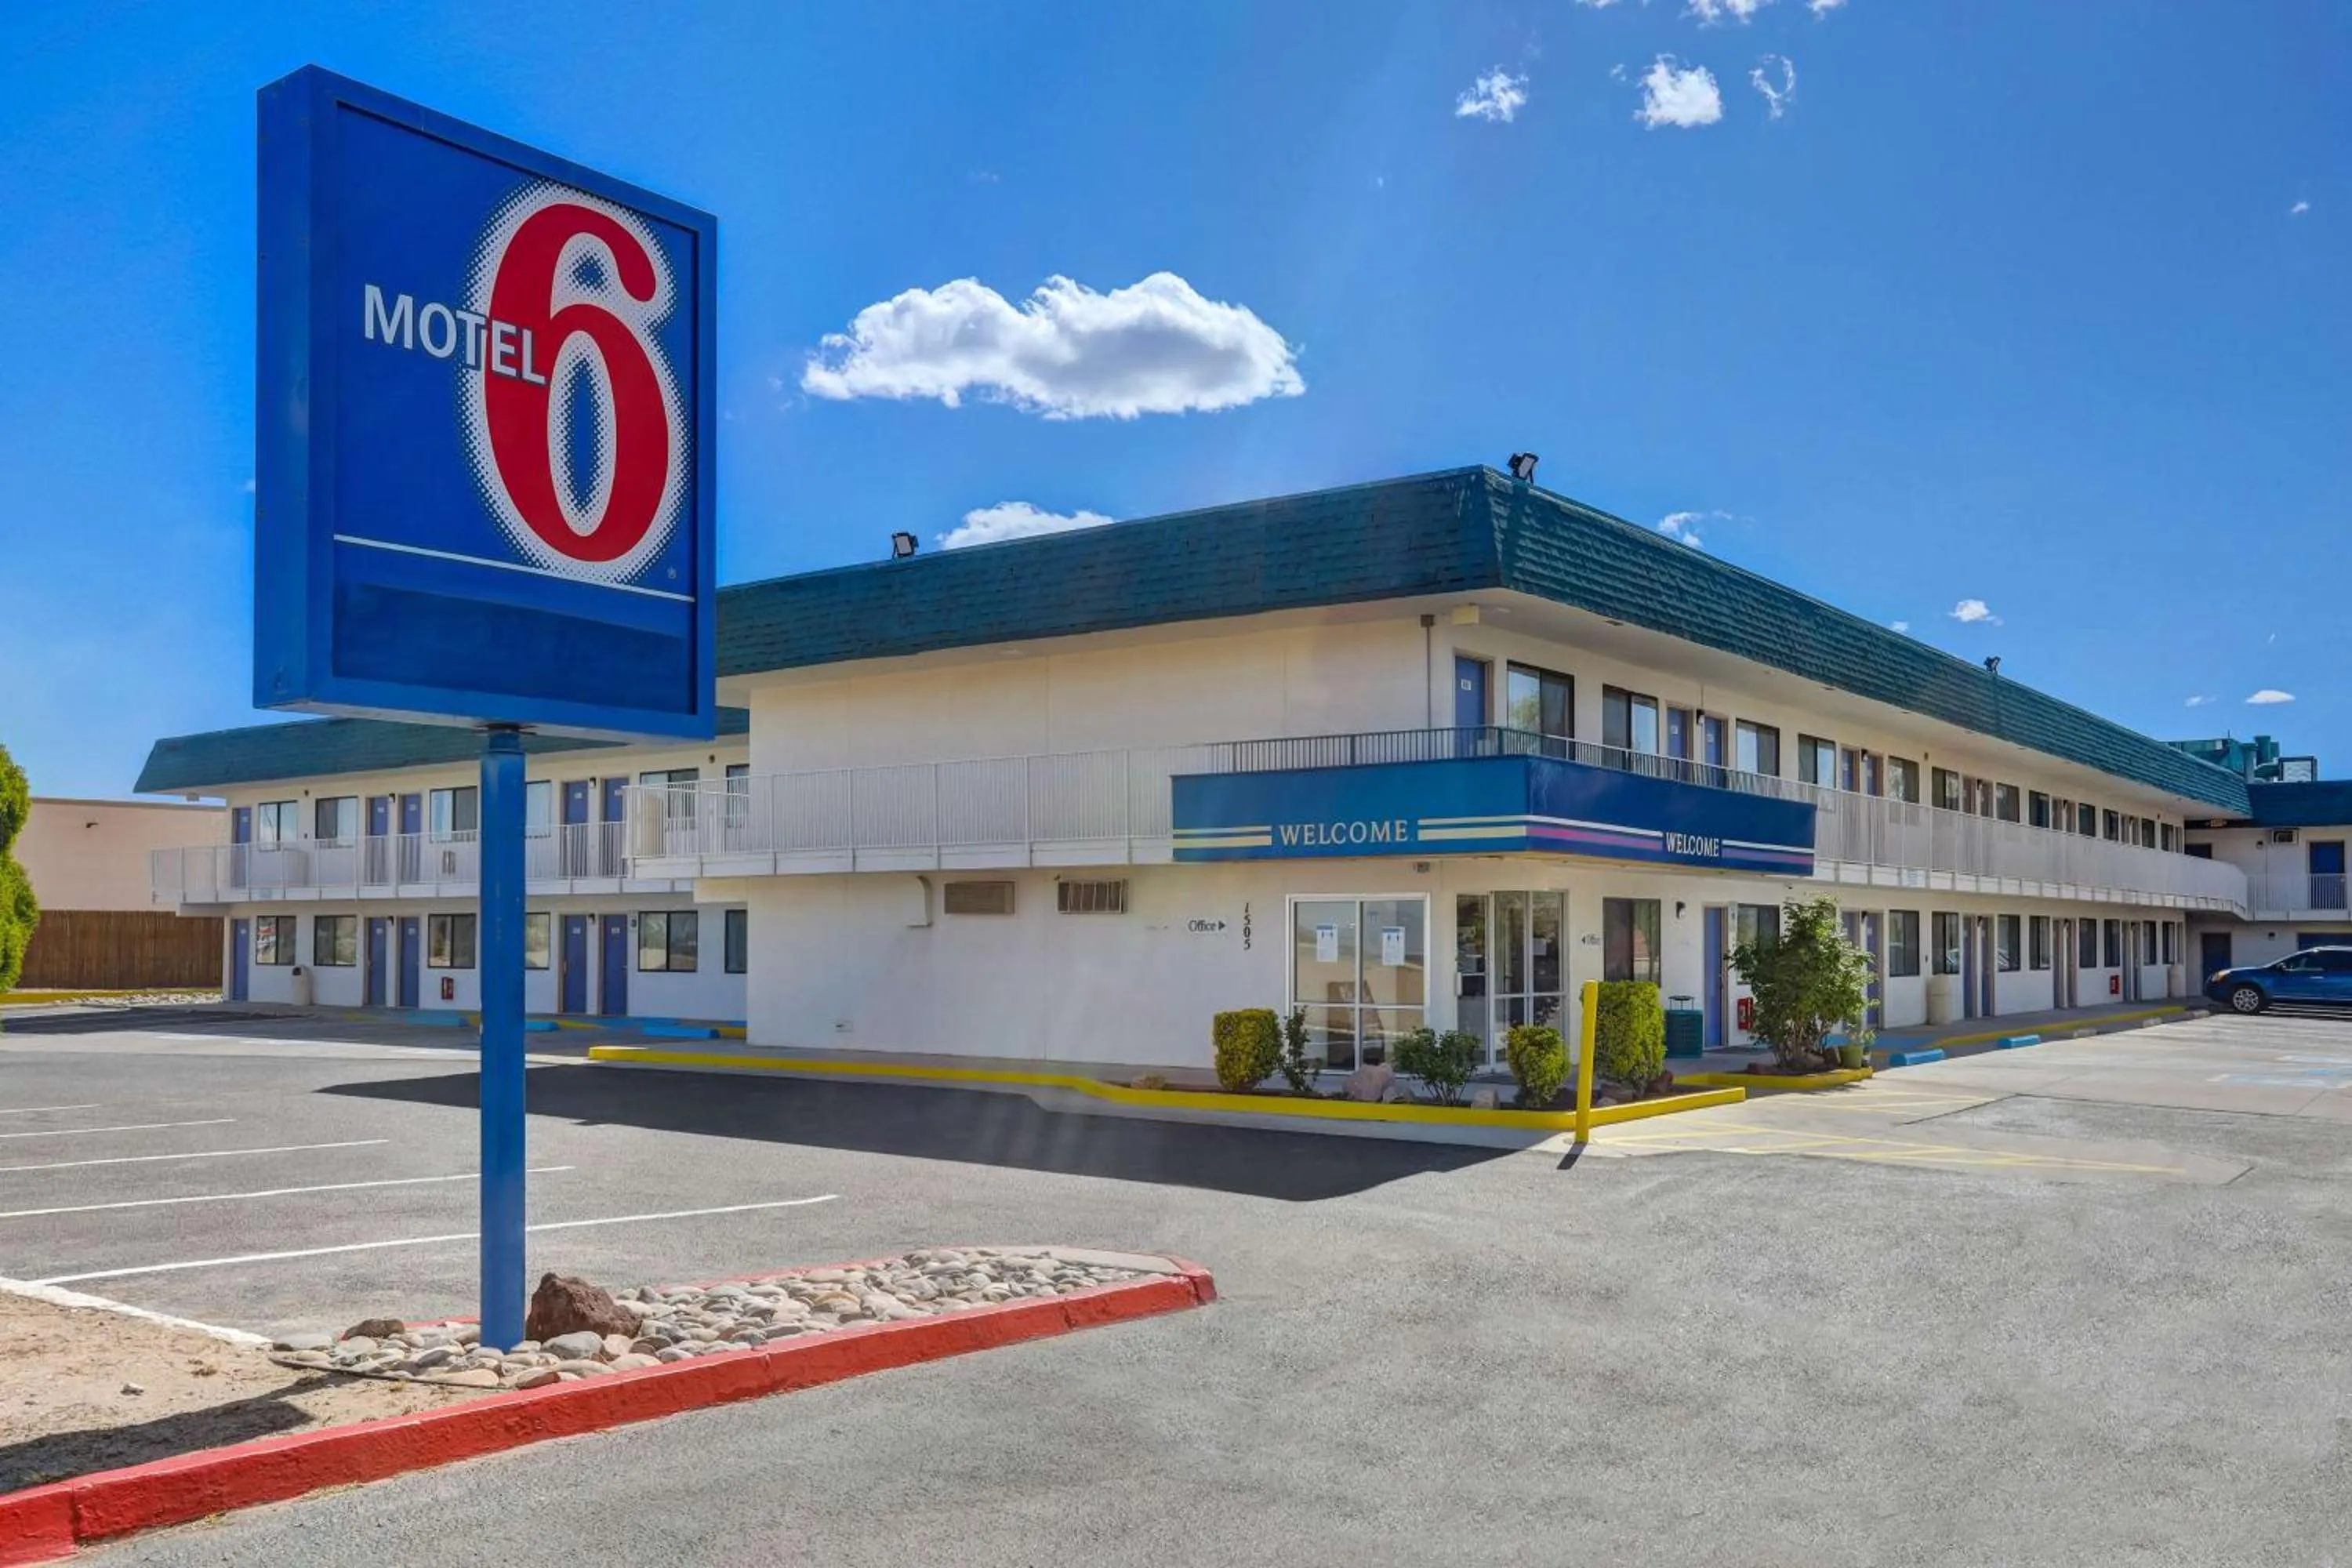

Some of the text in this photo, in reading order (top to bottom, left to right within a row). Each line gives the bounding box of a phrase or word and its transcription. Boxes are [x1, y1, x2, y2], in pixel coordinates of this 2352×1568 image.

[364, 201, 670, 563] MOTEL 6
[1279, 819, 1408, 846] WELCOME
[1666, 832, 1719, 857] WELCOME
[1187, 919, 1218, 933] Office
[1242, 902, 1252, 951] 1505
